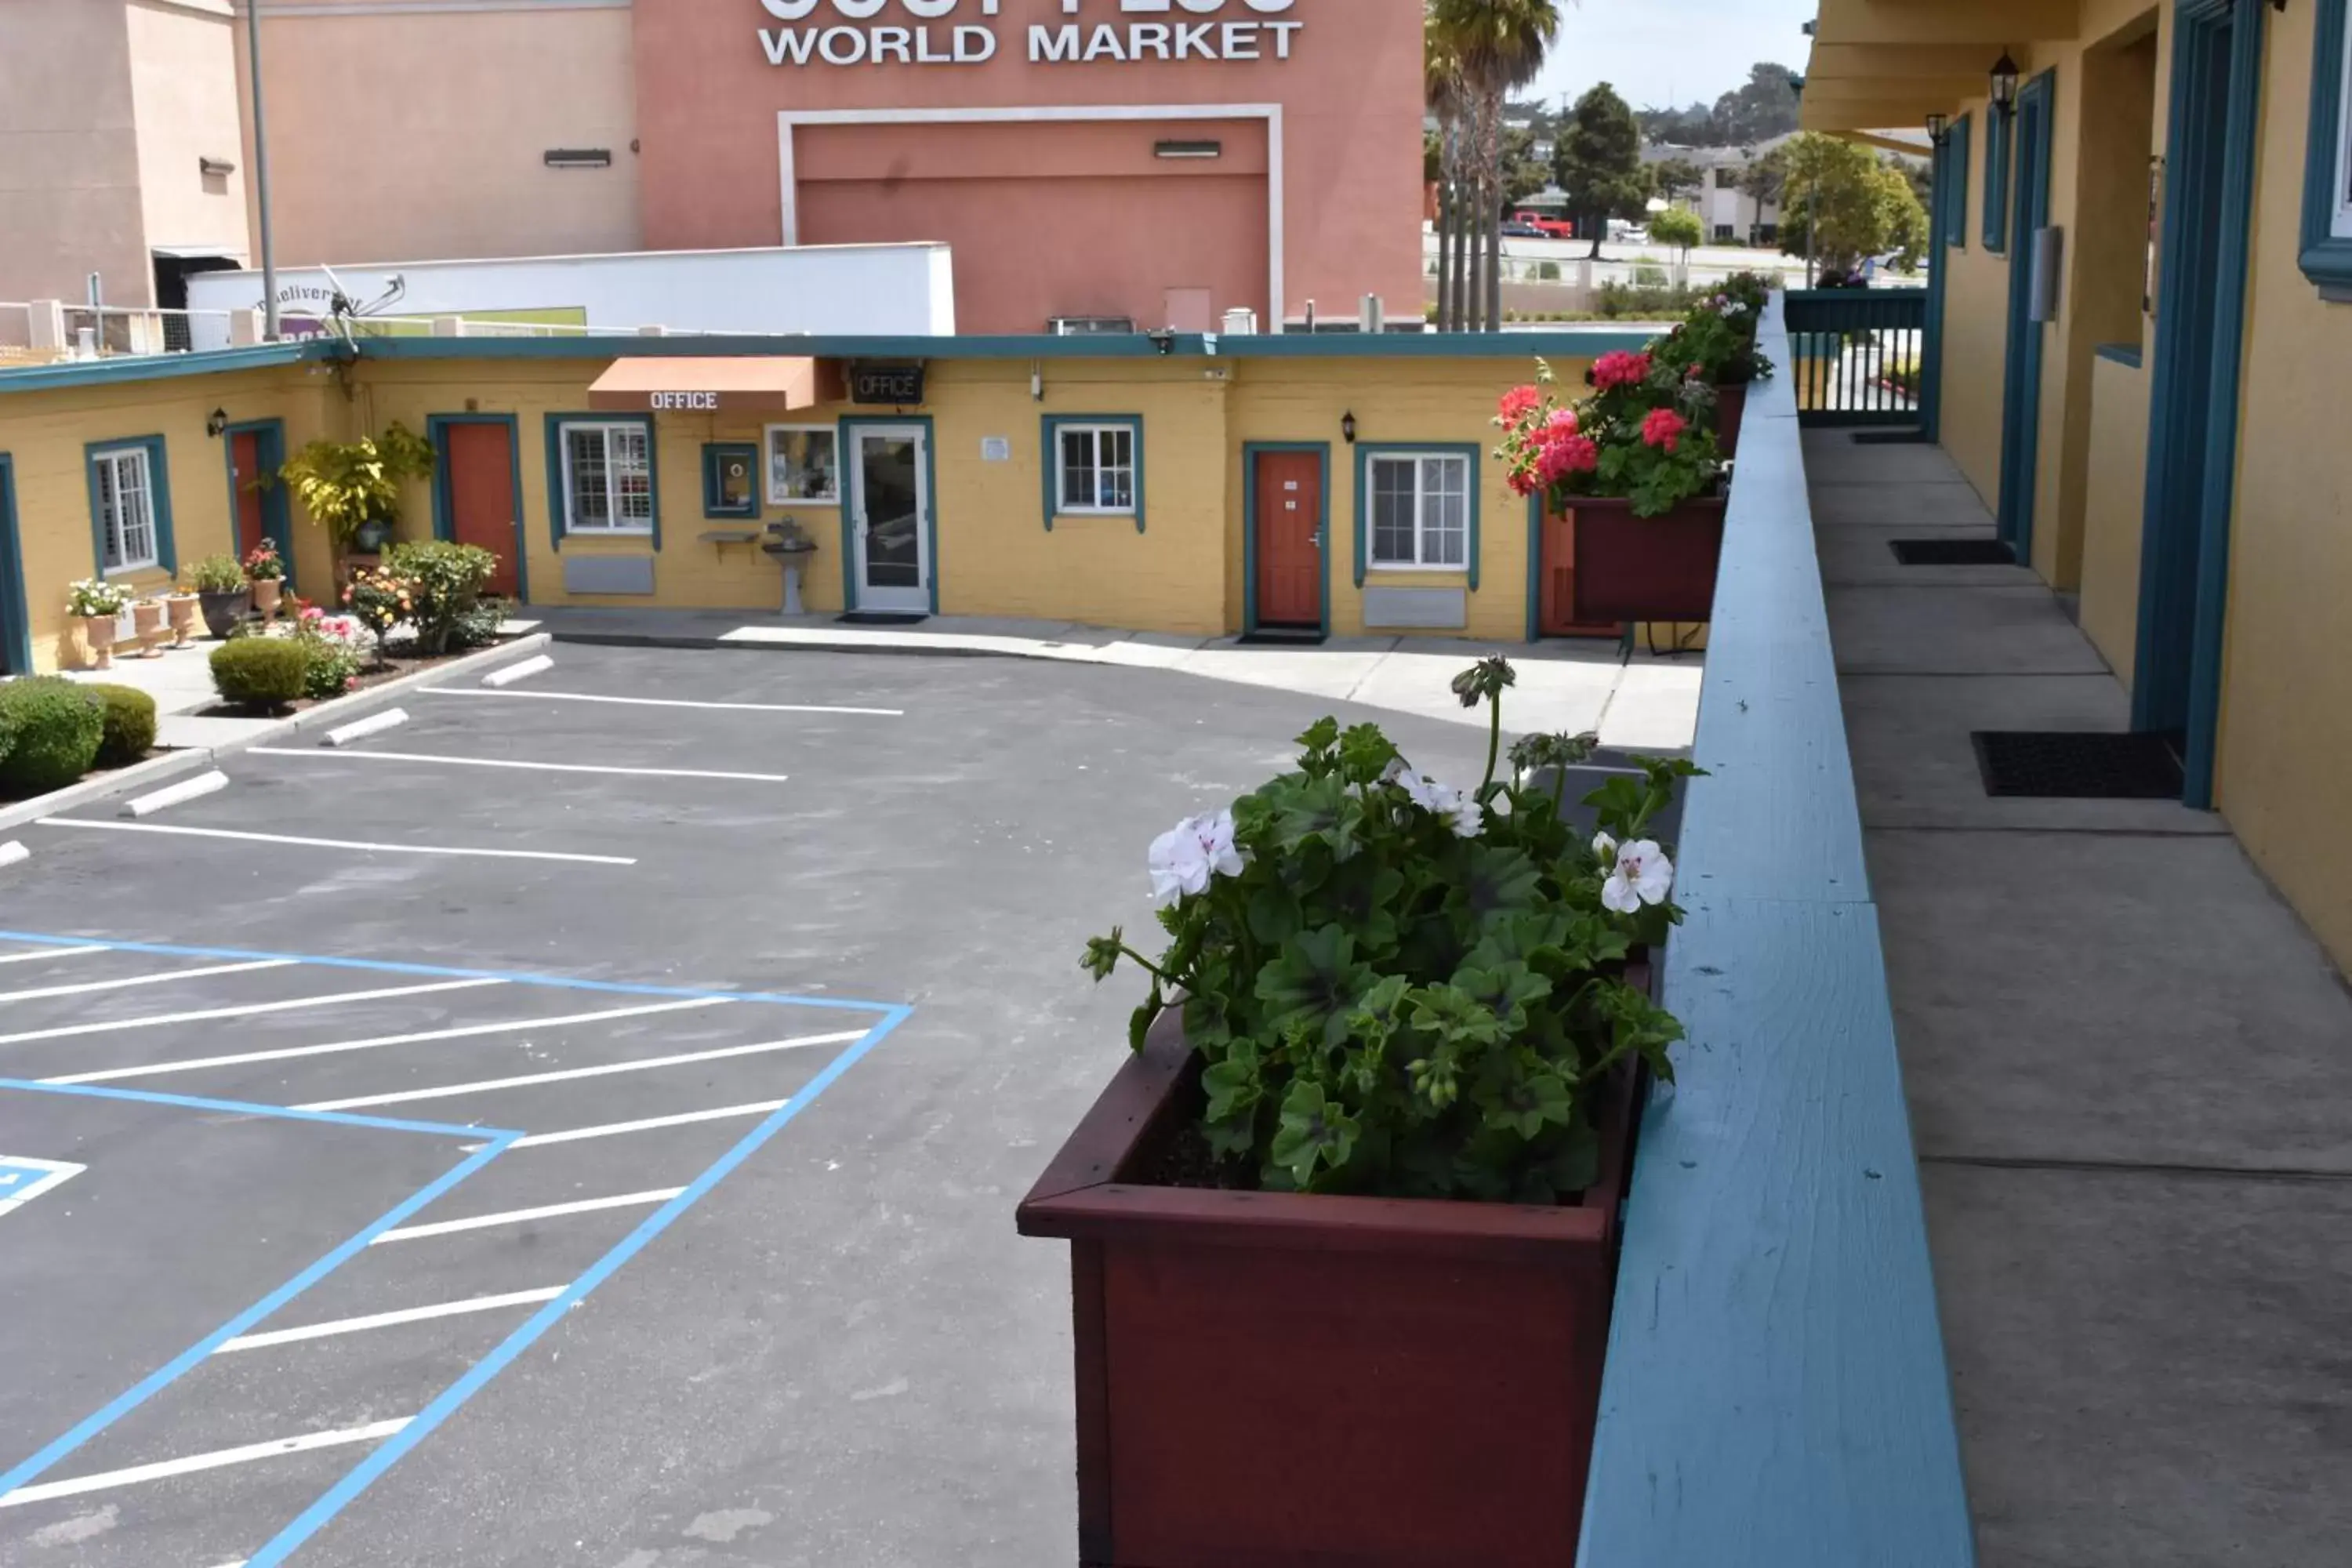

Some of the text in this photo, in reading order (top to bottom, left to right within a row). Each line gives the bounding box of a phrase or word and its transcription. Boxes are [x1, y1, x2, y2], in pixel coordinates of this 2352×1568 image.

[757, 21, 1304, 64] WORLD MARKET
[271, 285, 337, 307] eliver
[859, 376, 915, 396] OFFICE
[650, 391, 718, 408] OFFICE
